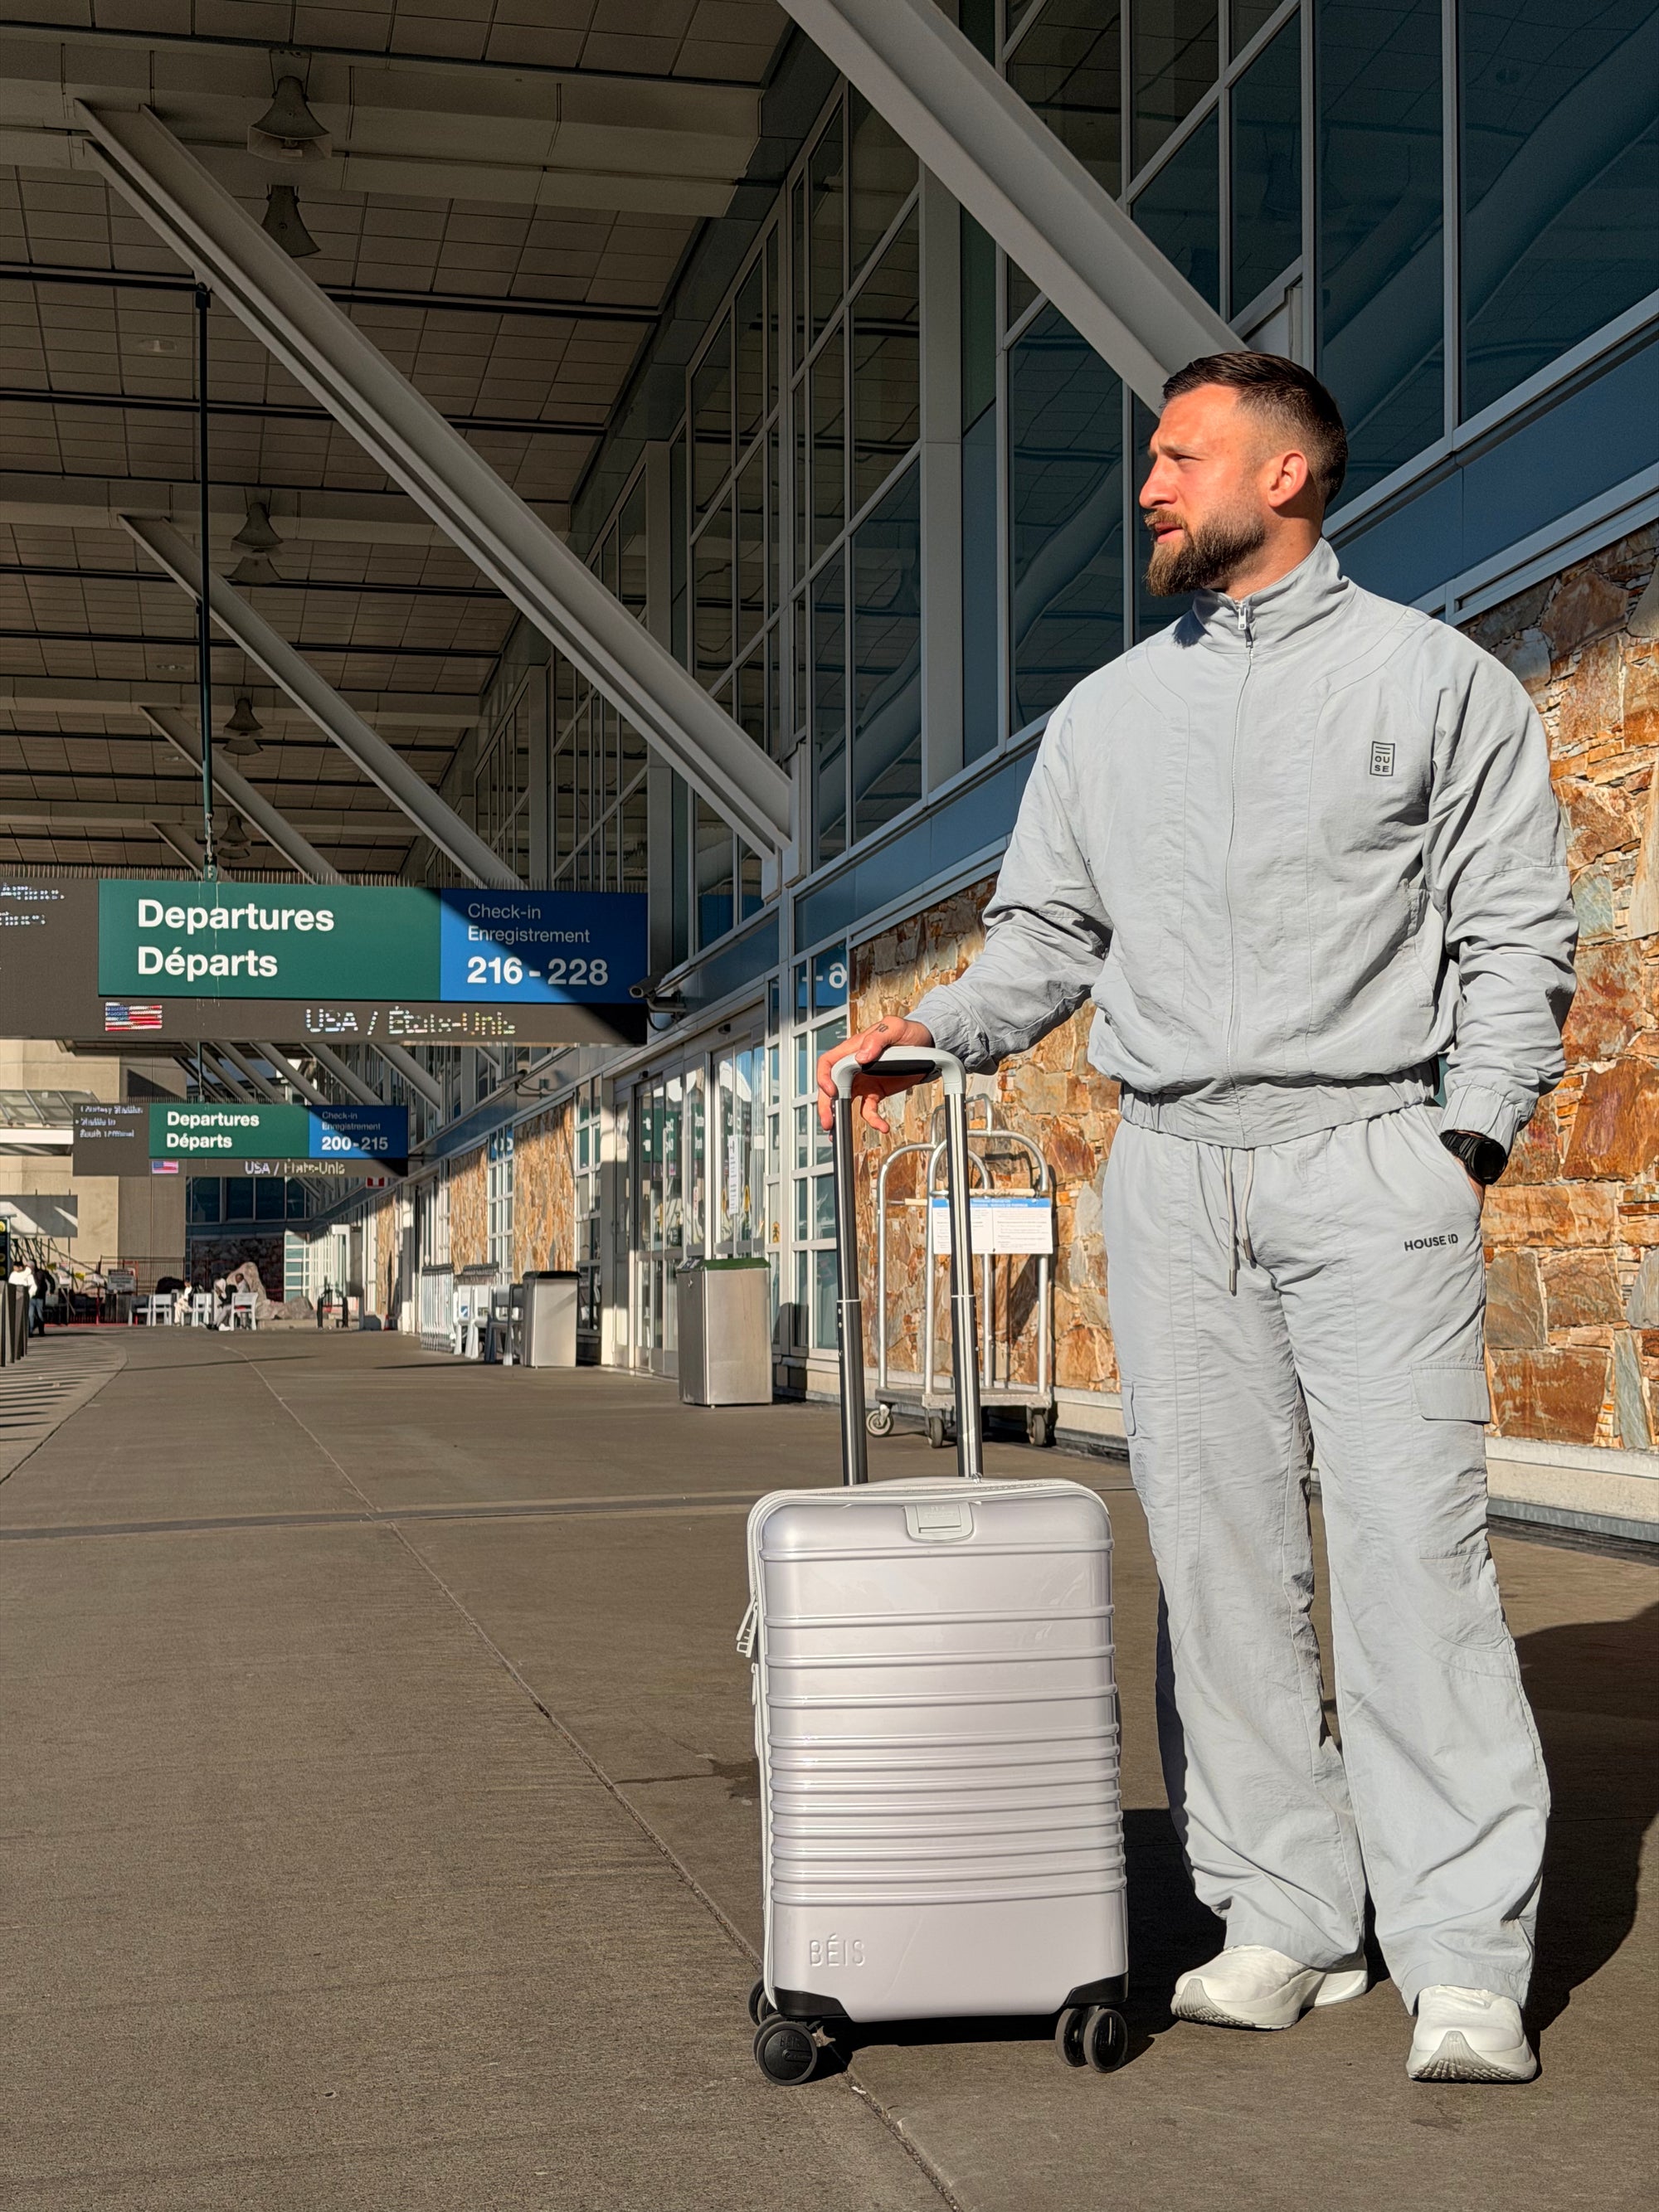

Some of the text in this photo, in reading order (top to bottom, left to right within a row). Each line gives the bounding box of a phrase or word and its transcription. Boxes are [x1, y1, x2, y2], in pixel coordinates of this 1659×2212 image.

[138, 898, 334, 935] Departures
[468, 902, 542, 920] Check-in
[467, 925, 591, 946] Enregistrement
[138, 946, 278, 982] Départs
[305, 1009, 358, 1033] USA
[167, 1111, 260, 1130] Departures
[322, 1111, 358, 1120] Check-in
[321, 1121, 381, 1131] Enregistrement
[166, 1132, 233, 1151] Départs
[245, 1160, 270, 1174] USA
[1404, 1235, 1447, 1252] HOUSE
[810, 1933, 865, 1966] BÉIS
